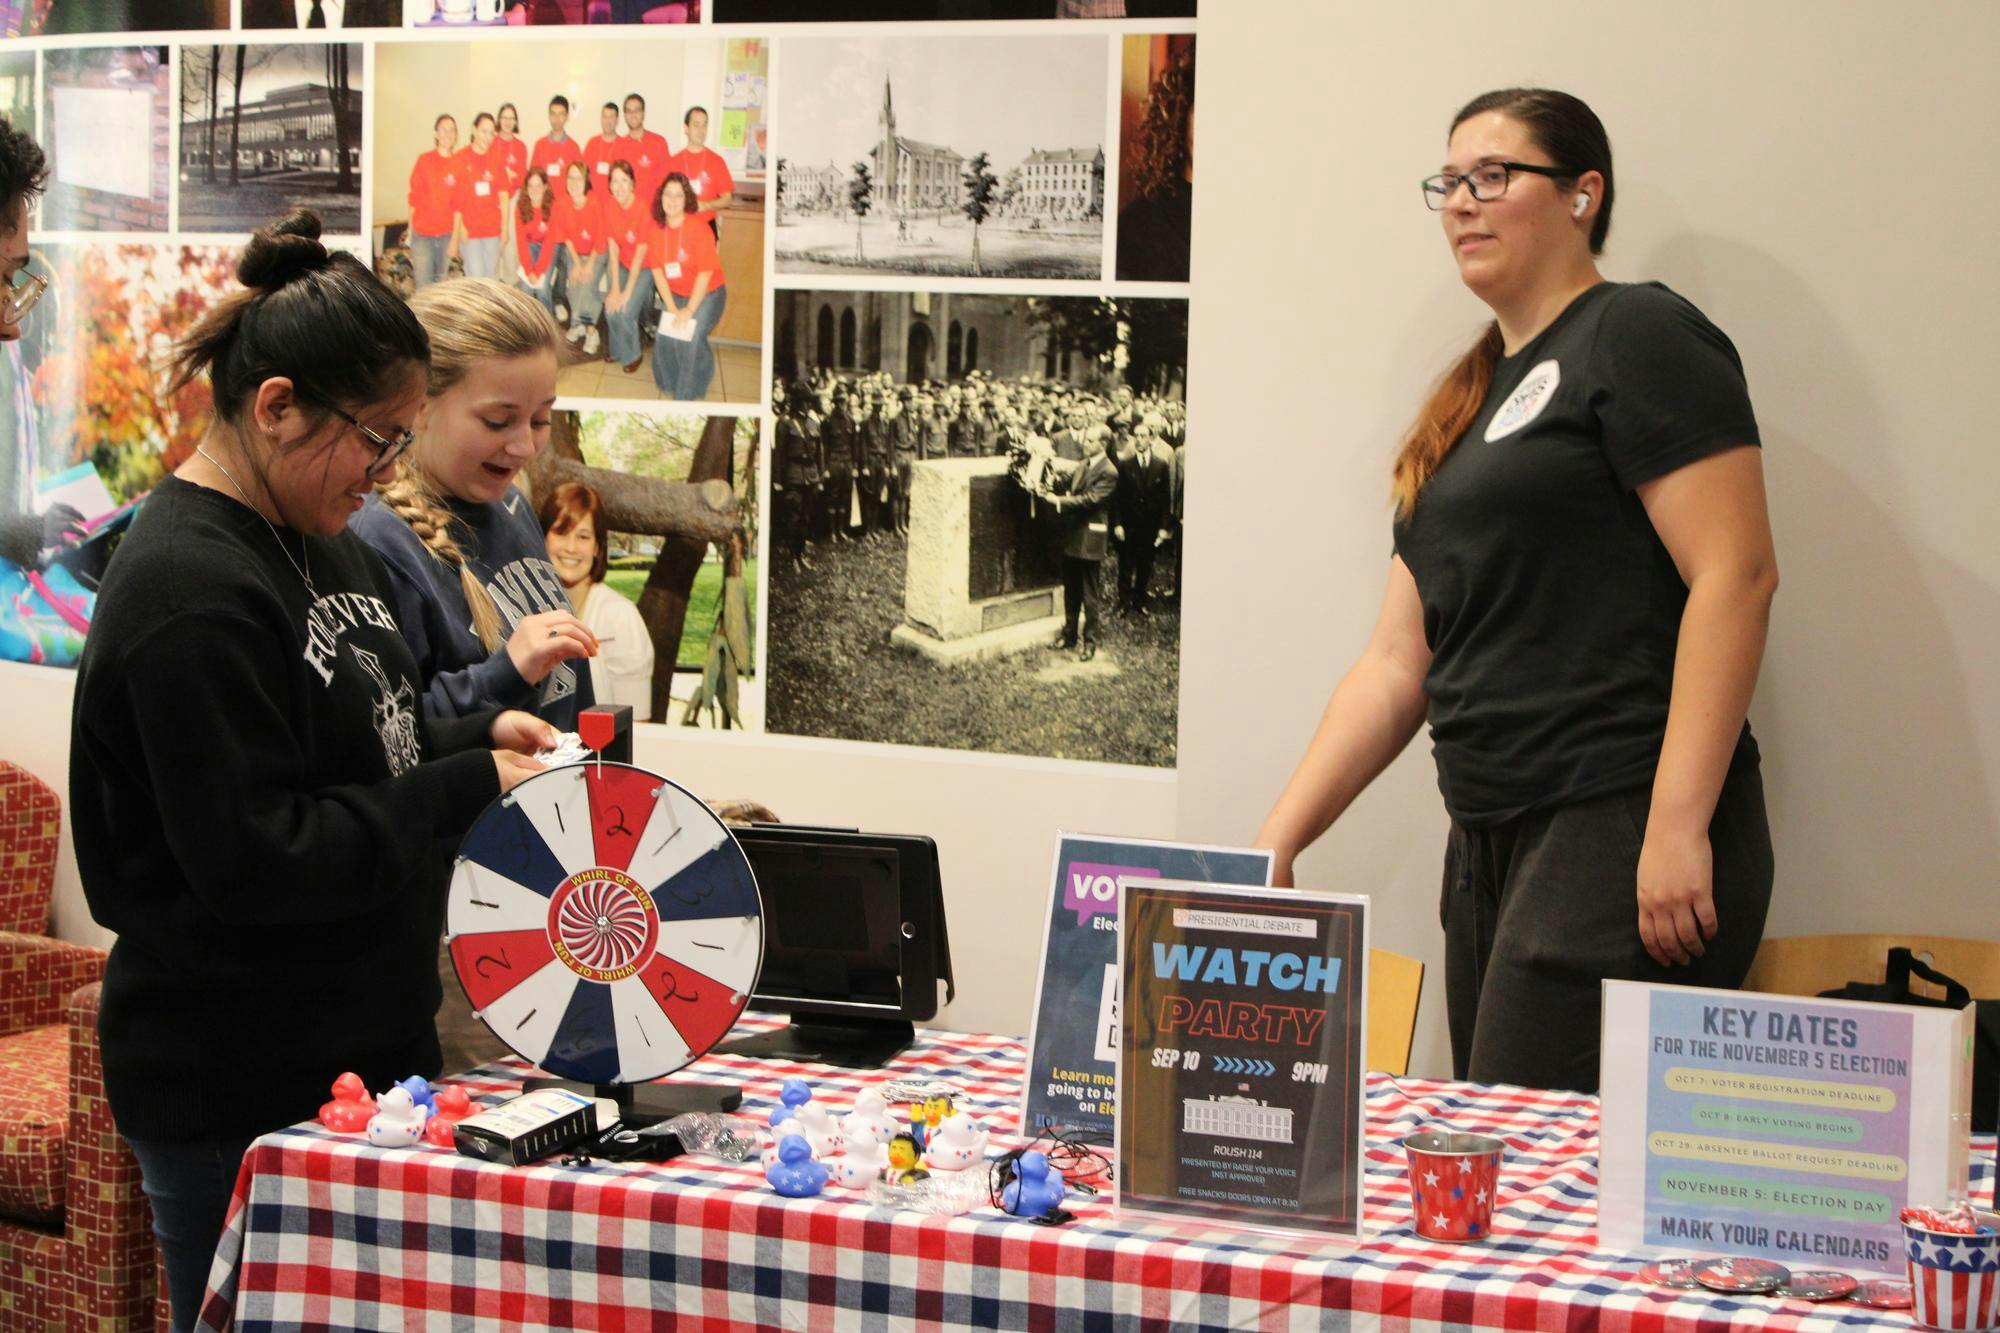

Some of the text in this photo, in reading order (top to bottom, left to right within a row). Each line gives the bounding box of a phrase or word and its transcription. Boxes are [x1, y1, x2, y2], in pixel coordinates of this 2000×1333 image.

[554, 801, 565, 834] 1
[603, 805, 633, 836] 2
[570, 870, 653, 911] WHIRL OF FUN
[1073, 873, 1119, 902] VO
[1188, 913, 1303, 933] PRESIDENTIAL DEBATE
[553, 942, 636, 980] WHIRL OF FUN
[1153, 942, 1342, 994] WATCH
[1158, 995, 1328, 1046] PARTY
[1703, 1006, 1857, 1048] KEY DATES
[1152, 1048, 1329, 1084] SEP 10 9PM
[1654, 1036, 1907, 1077] FOR THE NOVEMBER 5 ELECTION
[1053, 1067, 1090, 1083] Learn
[1675, 1075, 1697, 1084] OCT
[1712, 1079, 1745, 1089] VOTER
[1749, 1083, 1825, 1097] REGISTRATION
[1829, 1091, 1881, 1103] DEADLINE
[1047, 1083, 1084, 1100] going
[1087, 1087, 1101, 1099] to
[1079, 1102, 1096, 1113] on
[1700, 1110, 1720, 1120] OCT
[1736, 1115, 1768, 1125] EARLY
[1772, 1119, 1811, 1130] VOTING
[1816, 1122, 1854, 1134] BEGINS
[1181, 1158, 1296, 1177] PRESENTED BY RAISE YOUR VOICE
[1213, 1145, 1262, 1159] ROUSH 114
[1655, 1139, 1674, 1148] OCT
[1696, 1143, 1748, 1156] ABSENTEE
[1752, 1150, 1792, 1161] BALLOT
[1796, 1154, 1843, 1166] REQUEST
[1847, 1159, 1899, 1172] DEADLINE
[1179, 1187, 1196, 1195] FREE
[1228, 1191, 1250, 1201] DOORS
[1252, 1194, 1271, 1204] OPEN
[1272, 1197, 1282, 1205] AT
[1667, 1179, 1885, 1212] NOVEMBER 5: ELECTION DAY
[1661, 1216, 1889, 1261] MARK YOUR CALENDARS
